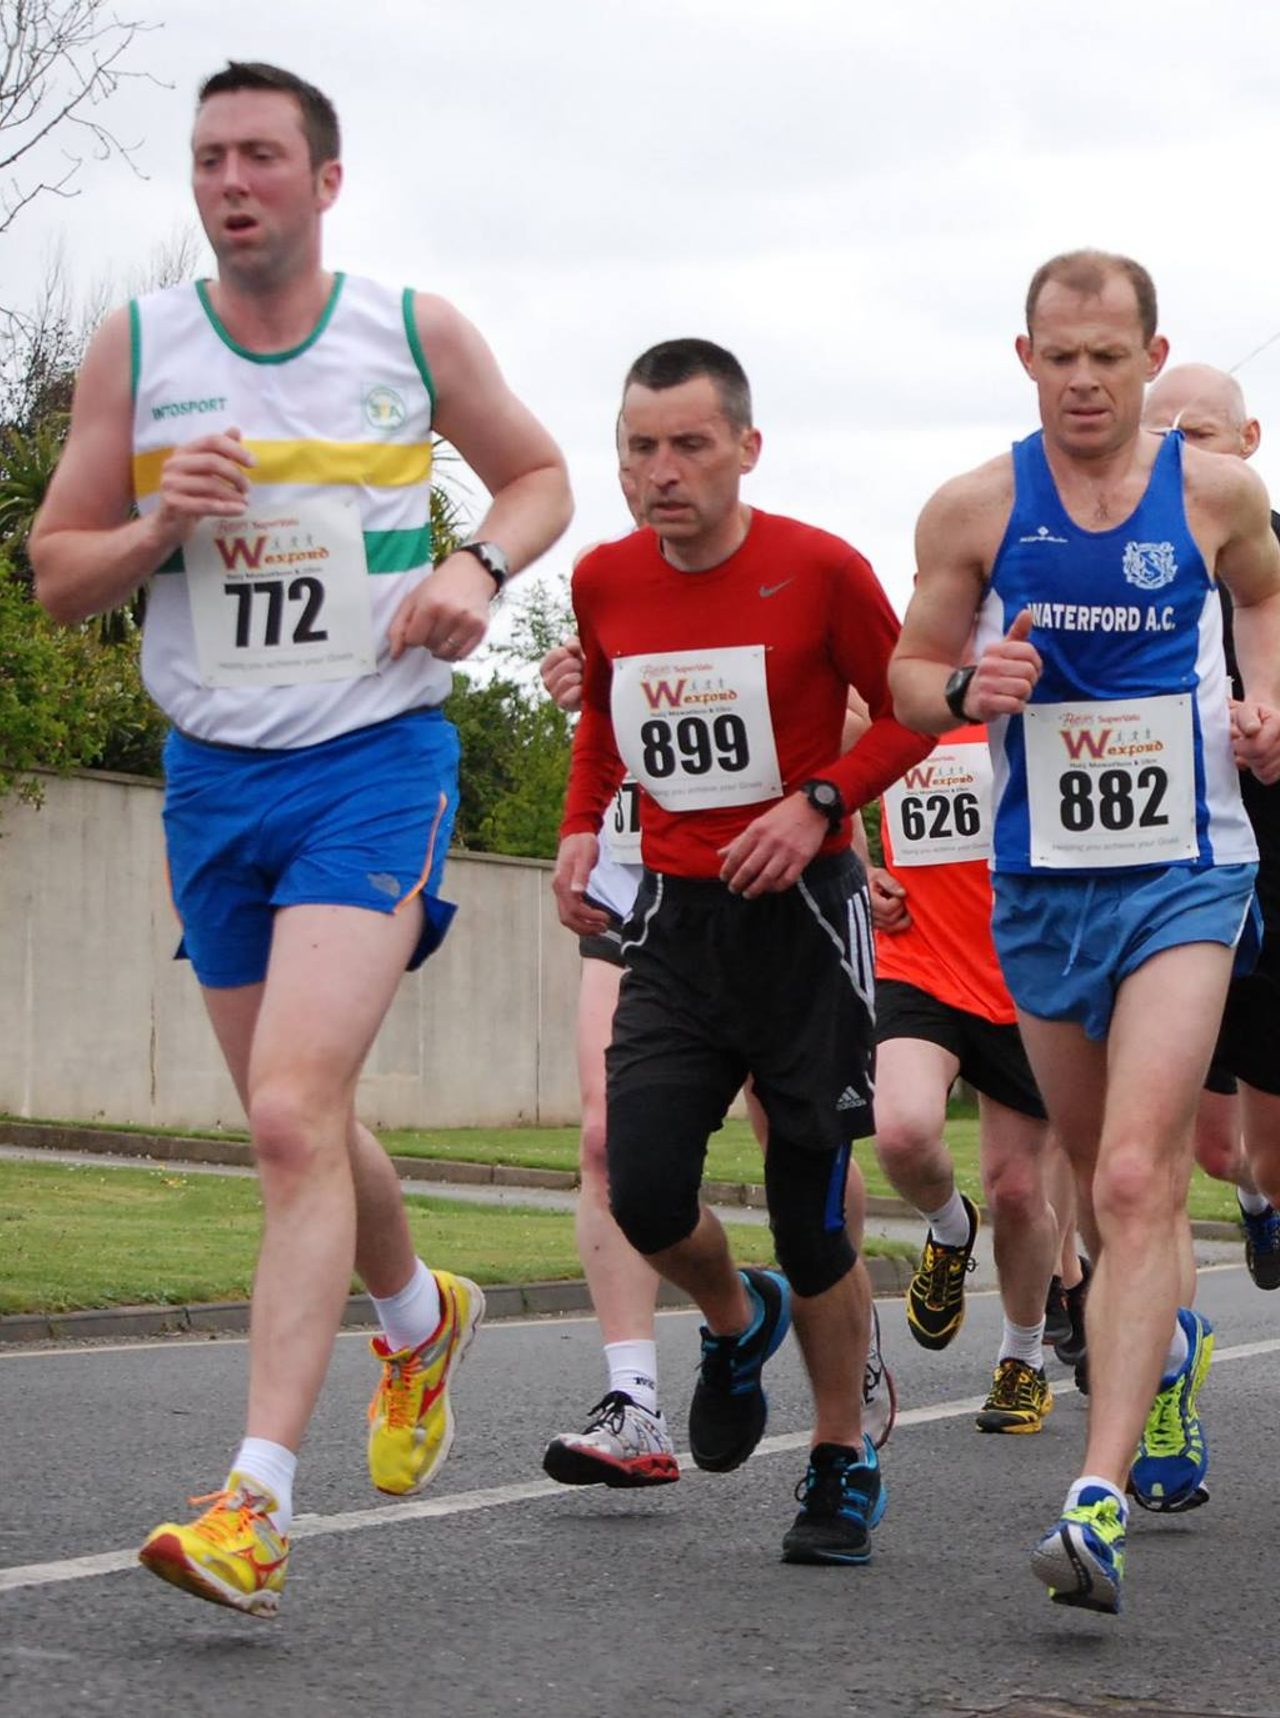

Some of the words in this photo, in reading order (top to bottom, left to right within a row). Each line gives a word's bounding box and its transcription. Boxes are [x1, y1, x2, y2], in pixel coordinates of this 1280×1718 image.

[224, 576, 328, 648] 772
[1027, 602, 1141, 633] WATERFORD
[1145, 606, 1176, 632] A.C.
[641, 679, 738, 710] Wexford
[640, 713, 751, 779] 899
[1060, 728, 1165, 760] Wexford
[901, 792, 981, 841] 626
[1059, 765, 1169, 832] 882
